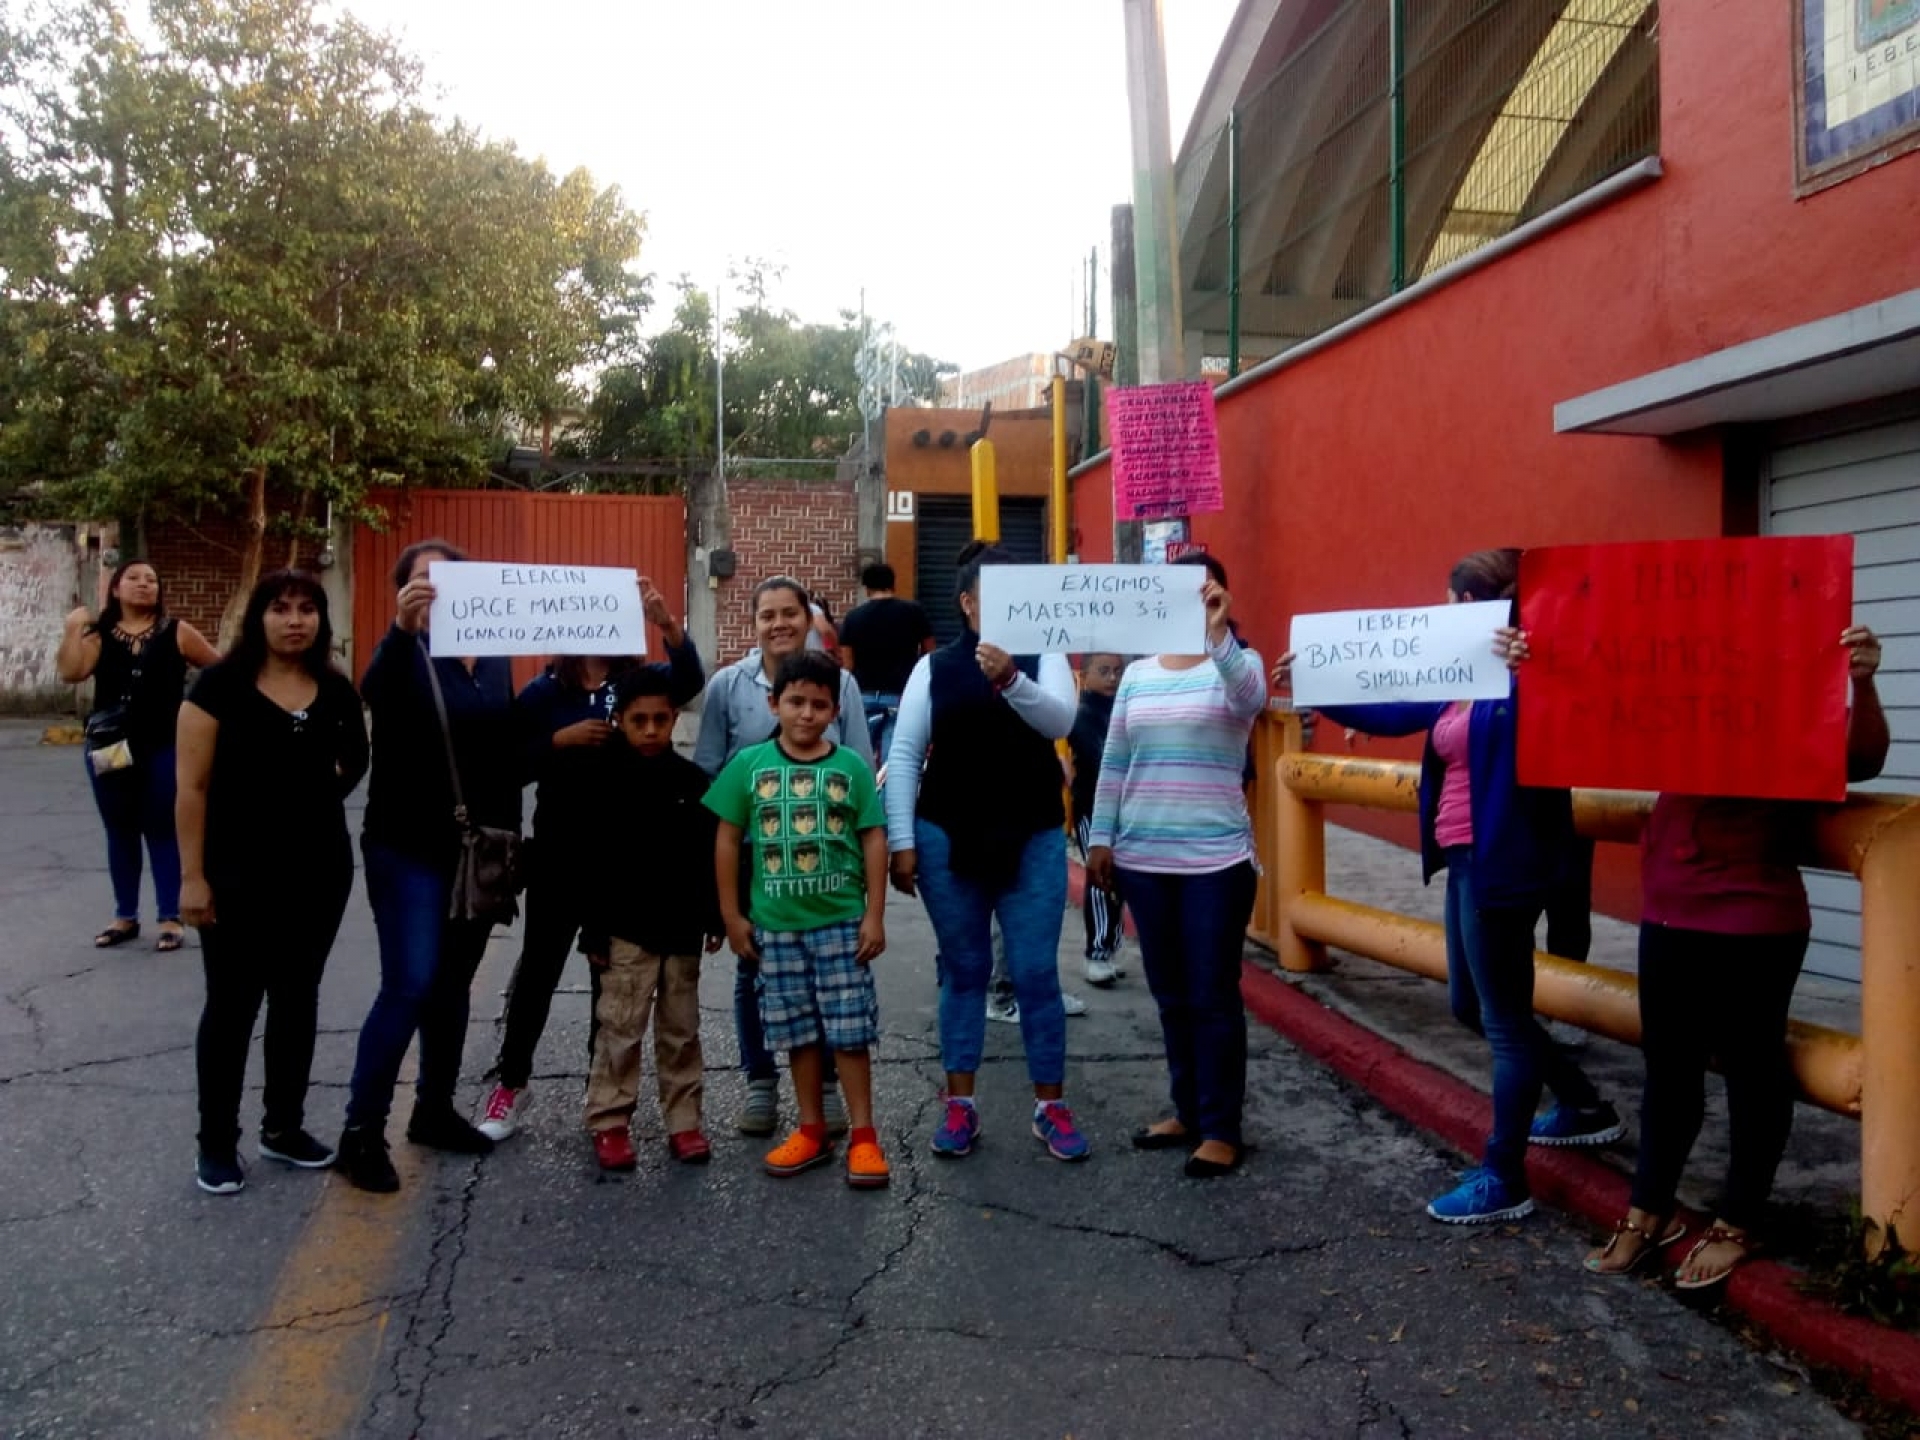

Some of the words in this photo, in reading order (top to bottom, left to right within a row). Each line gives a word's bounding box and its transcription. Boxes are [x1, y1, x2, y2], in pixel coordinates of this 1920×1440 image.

[887, 490, 914, 514] 10
[1061, 574, 1165, 594] EXIGIMOS
[451, 596, 518, 620] URGE
[529, 593, 620, 615] MAESTRO
[1007, 600, 1116, 622] MAESTRO
[456, 626, 526, 643] IGNACIO
[532, 623, 622, 642] ZARAGOZA
[1357, 612, 1430, 632] IEBEM
[1041, 626, 1072, 648] YA
[1305, 640, 1384, 669] BASTA
[1392, 635, 1422, 658] DE
[1355, 656, 1475, 690] SIMULACIÓN
